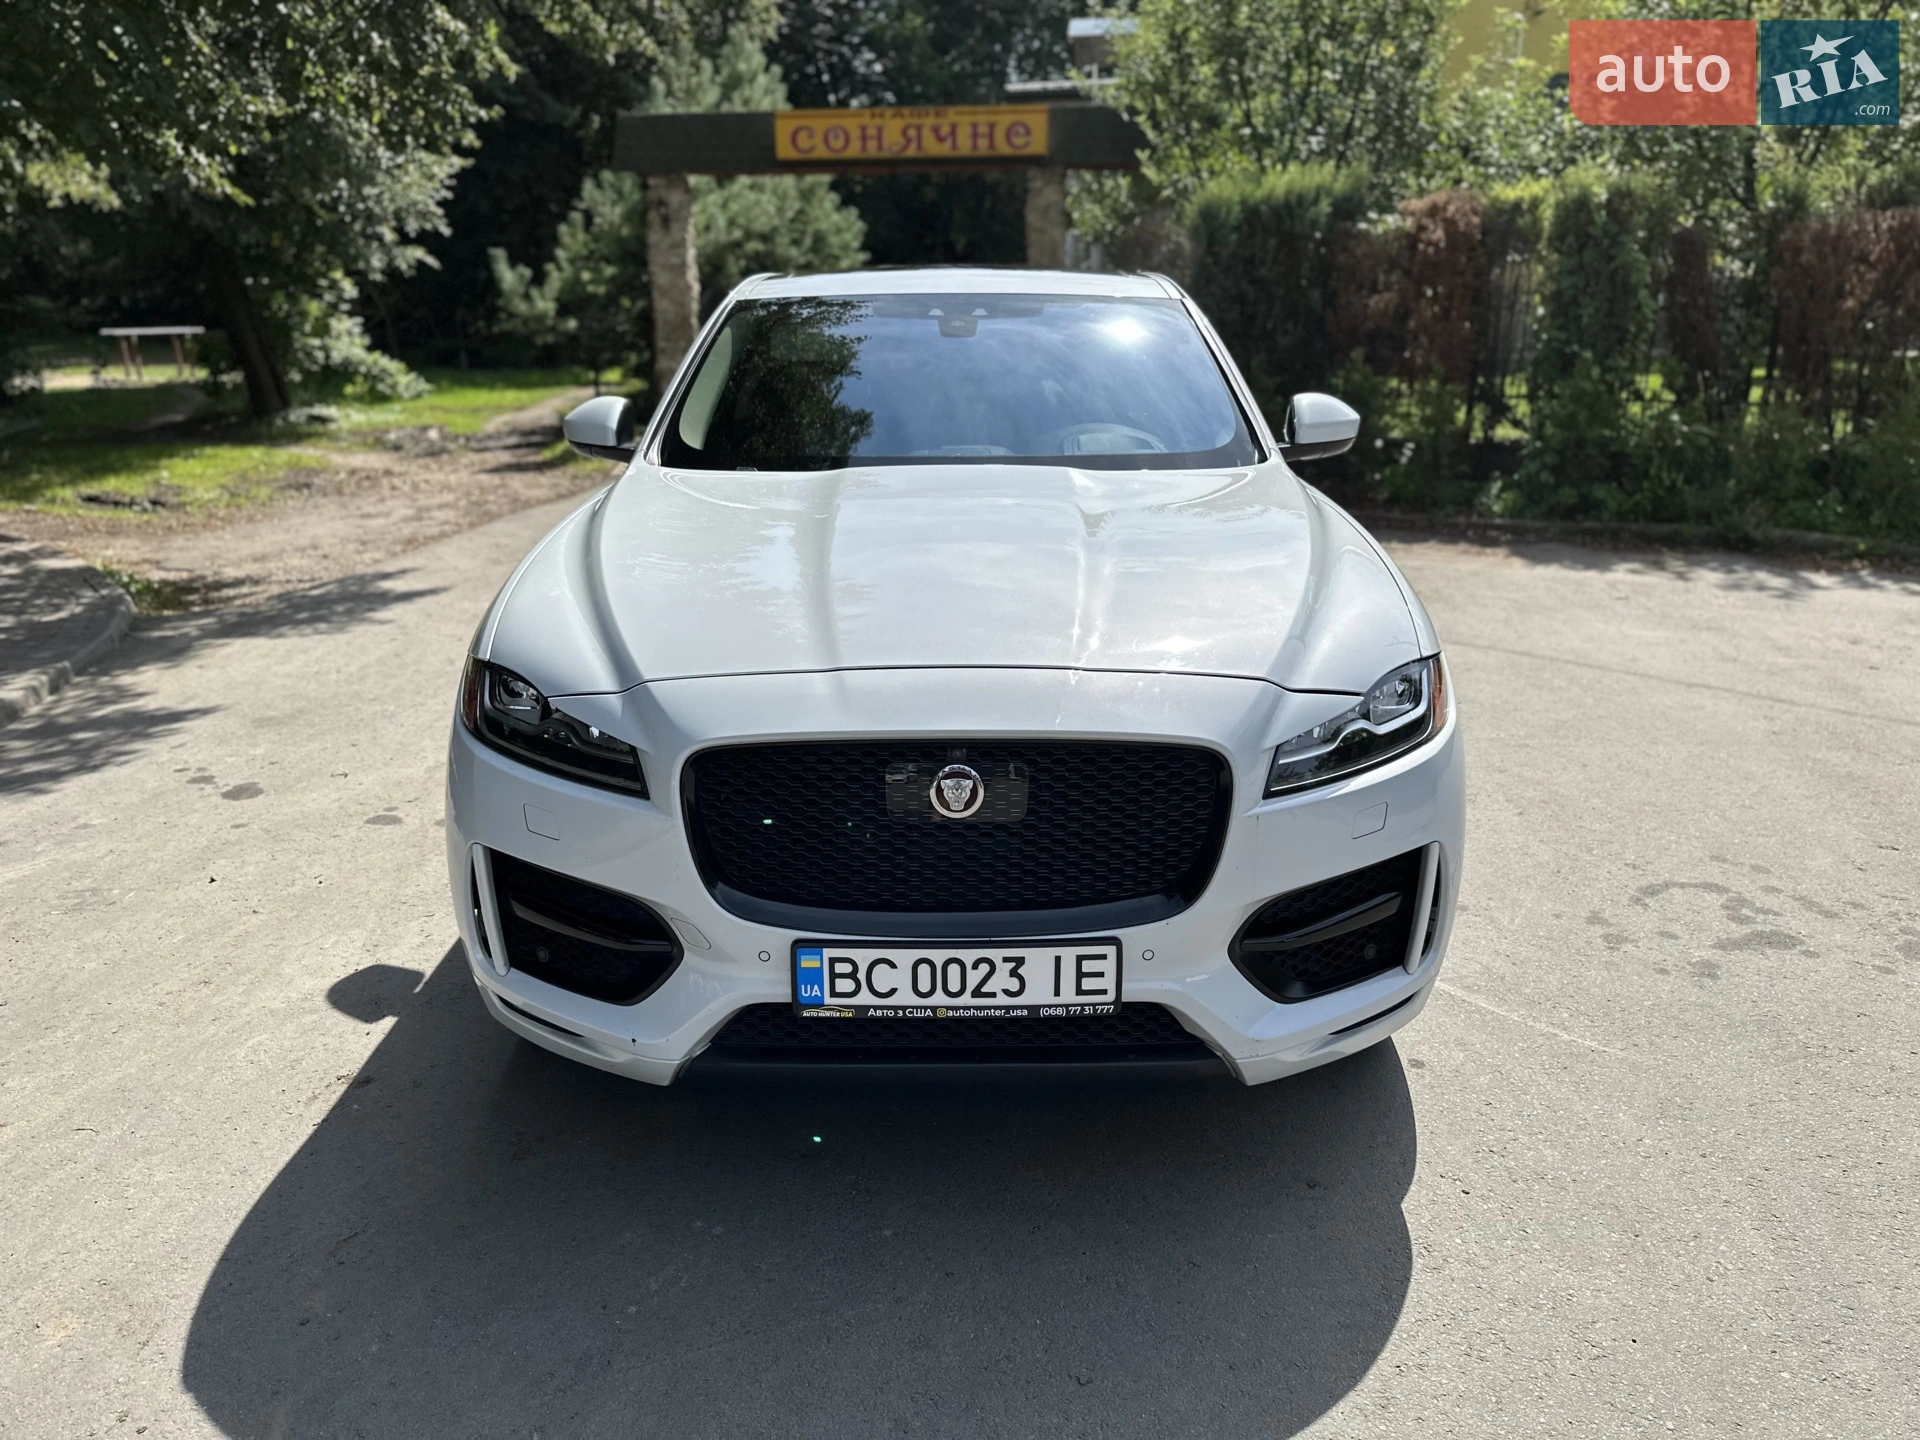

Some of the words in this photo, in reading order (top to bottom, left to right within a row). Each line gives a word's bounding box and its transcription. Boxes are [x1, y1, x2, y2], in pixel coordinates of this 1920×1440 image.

[828, 956, 899, 999] BC
[911, 956, 1026, 999] 0023
[1053, 954, 1108, 998] IE
[801, 984, 822, 998] UA
[905, 1008, 933, 1017] США
[1039, 1006, 1066, 1017] (068)
[1068, 1006, 1082, 1015] 77
[1084, 1006, 1094, 1014] 31
[1095, 1005, 1115, 1014] 777
